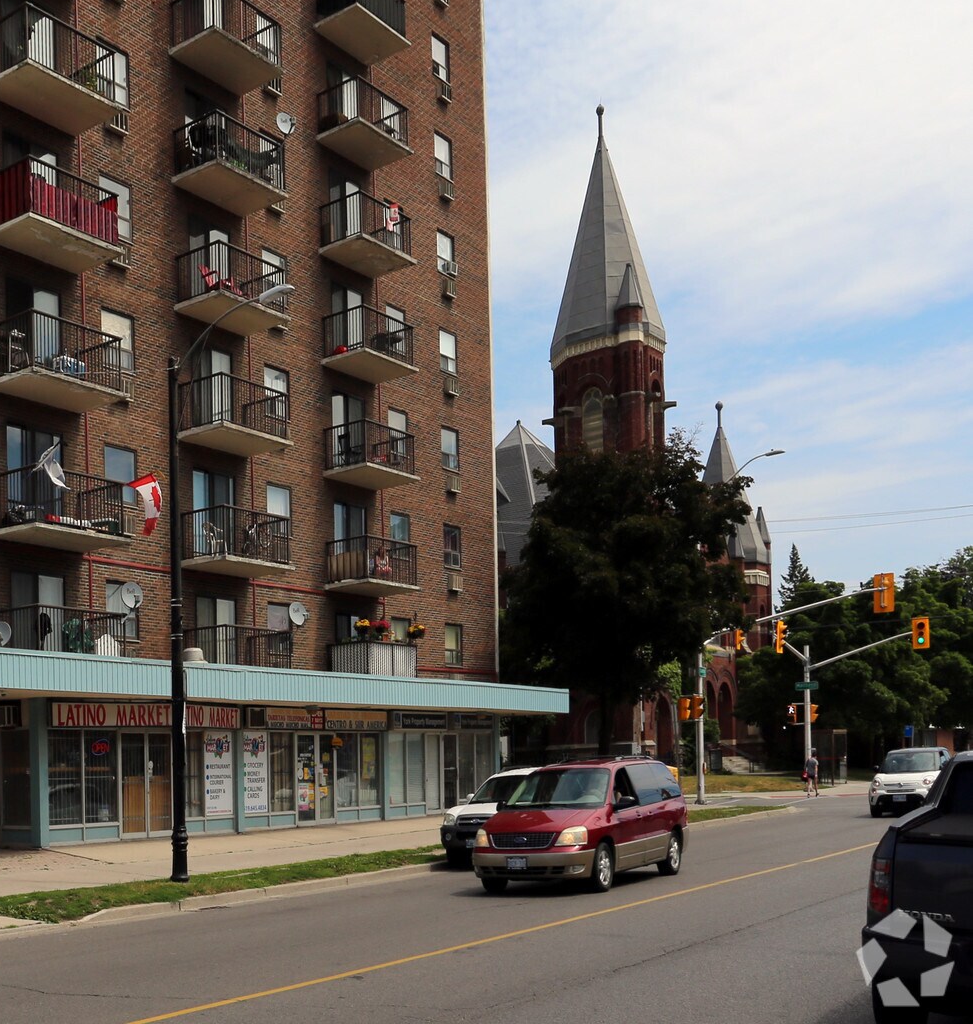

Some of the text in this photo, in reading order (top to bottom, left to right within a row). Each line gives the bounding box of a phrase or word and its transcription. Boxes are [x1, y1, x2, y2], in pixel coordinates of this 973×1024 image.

[57, 704, 171, 727] LATINO MARKET
[186, 706, 239, 727] TINO MARKET
[327, 719, 347, 729] CENTRO
[349, 720, 353, 729] &
[92, 742, 110, 753] OPEN
[899, 909, 955, 923] ONDA
